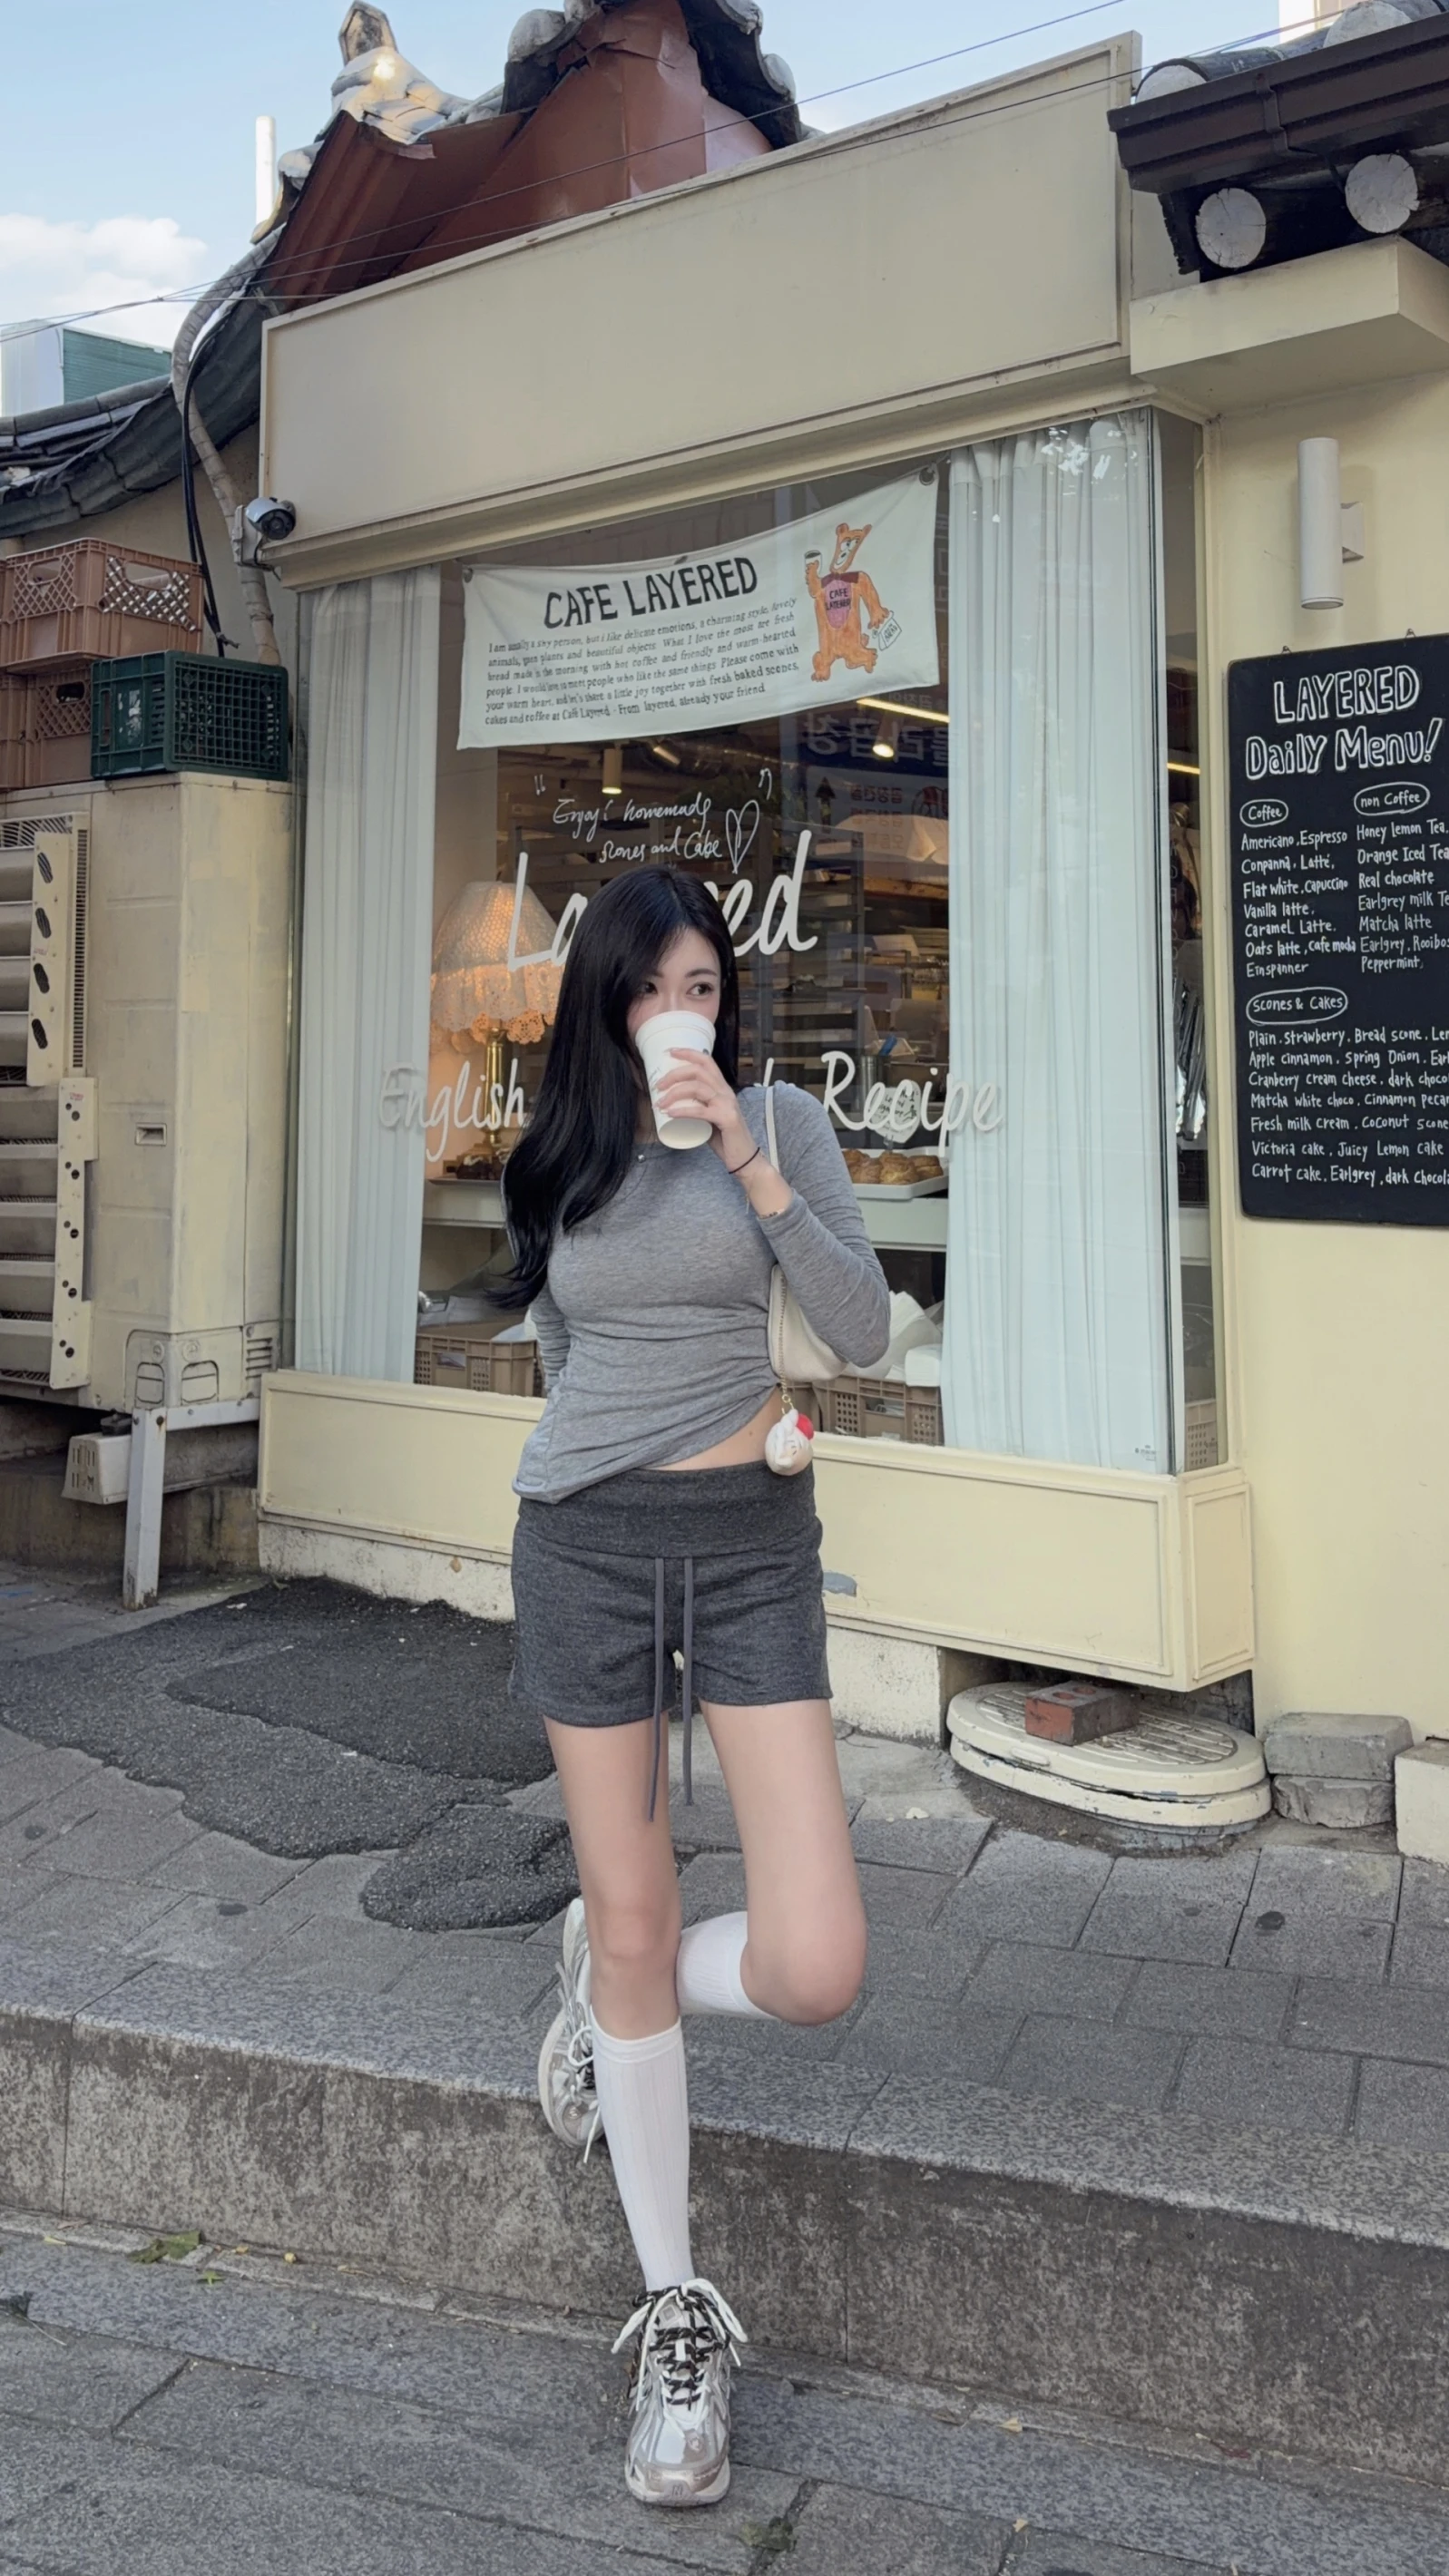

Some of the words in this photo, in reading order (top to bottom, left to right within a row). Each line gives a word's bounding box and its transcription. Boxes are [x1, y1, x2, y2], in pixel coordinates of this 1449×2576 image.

[544, 583, 618, 629] CAFE
[622, 557, 758, 616] LAYERED
[829, 588, 848, 600] CAFE
[494, 644, 506, 652] am
[586, 635, 600, 644] but
[606, 631, 622, 642] like
[624, 628, 655, 640] delicate
[706, 611, 746, 627] charming
[771, 597, 797, 611] lovely
[541, 650, 563, 666] plants
[567, 649, 583, 659] and
[586, 646, 623, 659] beautiful
[662, 635, 684, 648] What
[687, 635, 691, 644] I
[695, 632, 713, 644] love
[717, 628, 729, 639] the
[733, 624, 754, 636] most
[758, 619, 769, 629] are
[775, 611, 795, 625] fresh
[488, 671, 510, 681] bread
[555, 664, 588, 675] morning
[592, 660, 612, 672] with
[614, 659, 628, 669] hot
[632, 653, 657, 668] coffee
[661, 651, 677, 662] and
[680, 645, 713, 660] friendly
[717, 642, 733, 653] and
[587, 675, 614, 689] people
[617, 673, 633, 683] who
[637, 669, 651, 682] like
[653, 666, 666, 678] the
[668, 664, 689, 677] same
[720, 654, 748, 668] Please
[749, 649, 775, 662] come
[777, 643, 799, 657] with
[486, 701, 504, 713] your
[506, 699, 528, 709] warm
[584, 691, 604, 702] share
[613, 688, 632, 698] little
[635, 687, 649, 698] joy
[651, 682, 686, 696] together
[688, 678, 707, 689] with
[710, 673, 732, 686] fresh
[734, 666, 763, 680] baked
[1274, 665, 1421, 724] LAYERED
[485, 715, 508, 726] cakes
[509, 713, 524, 724] and
[524, 710, 550, 723] coffee
[552, 711, 560, 720] at
[618, 703, 641, 715] From
[679, 693, 711, 707] already
[713, 689, 735, 704] your
[1246, 733, 1327, 780] Daily
[1335, 717, 1444, 771] Menu!
[1361, 796, 1380, 808] non
[1385, 789, 1421, 805] Coffee
[622, 791, 711, 838] homemade
[1248, 804, 1283, 822] Coffee
[651, 825, 681, 856] and
[1299, 830, 1348, 851] Espresso
[1356, 824, 1387, 845] Honey
[1357, 848, 1399, 865] Orange
[1402, 844, 1426, 862] Iced
[1429, 844, 1449, 861] Tea
[1358, 871, 1380, 890] Real
[1385, 869, 1435, 887] chocolate
[508, 830, 818, 971] Laed
[1243, 881, 1268, 900] Flat
[1243, 902, 1278, 920] Vanilla
[1357, 892, 1406, 912] Earlgrey
[1409, 891, 1434, 908] milk
[1359, 914, 1399, 932] Matcha
[1405, 912, 1433, 931] latte
[1245, 940, 1274, 958] Oats
[1247, 961, 1309, 979] Einspanner
[1295, 997, 1304, 1010] &
[1355, 1025, 1386, 1044] Bread
[1248, 1050, 1276, 1069] Apple
[1248, 1071, 1299, 1092] Cranberry
[1306, 1072, 1337, 1087] cream
[1388, 1068, 1415, 1088] dark
[379, 1058, 526, 1163] English
[821, 1050, 1004, 1157] Recipe
[1250, 1092, 1288, 1108] Matcha
[1294, 1092, 1323, 1107] white
[1250, 1114, 1283, 1133] Fresh
[1287, 1116, 1312, 1132] milk
[1252, 1140, 1296, 1156] Victoria
[1337, 1141, 1368, 1163] Juicy
[1377, 1139, 1410, 1157] Lemon
[1417, 1139, 1444, 1156] cake
[1252, 1163, 1293, 1183] Carrot
[1385, 1166, 1410, 1185] dark
